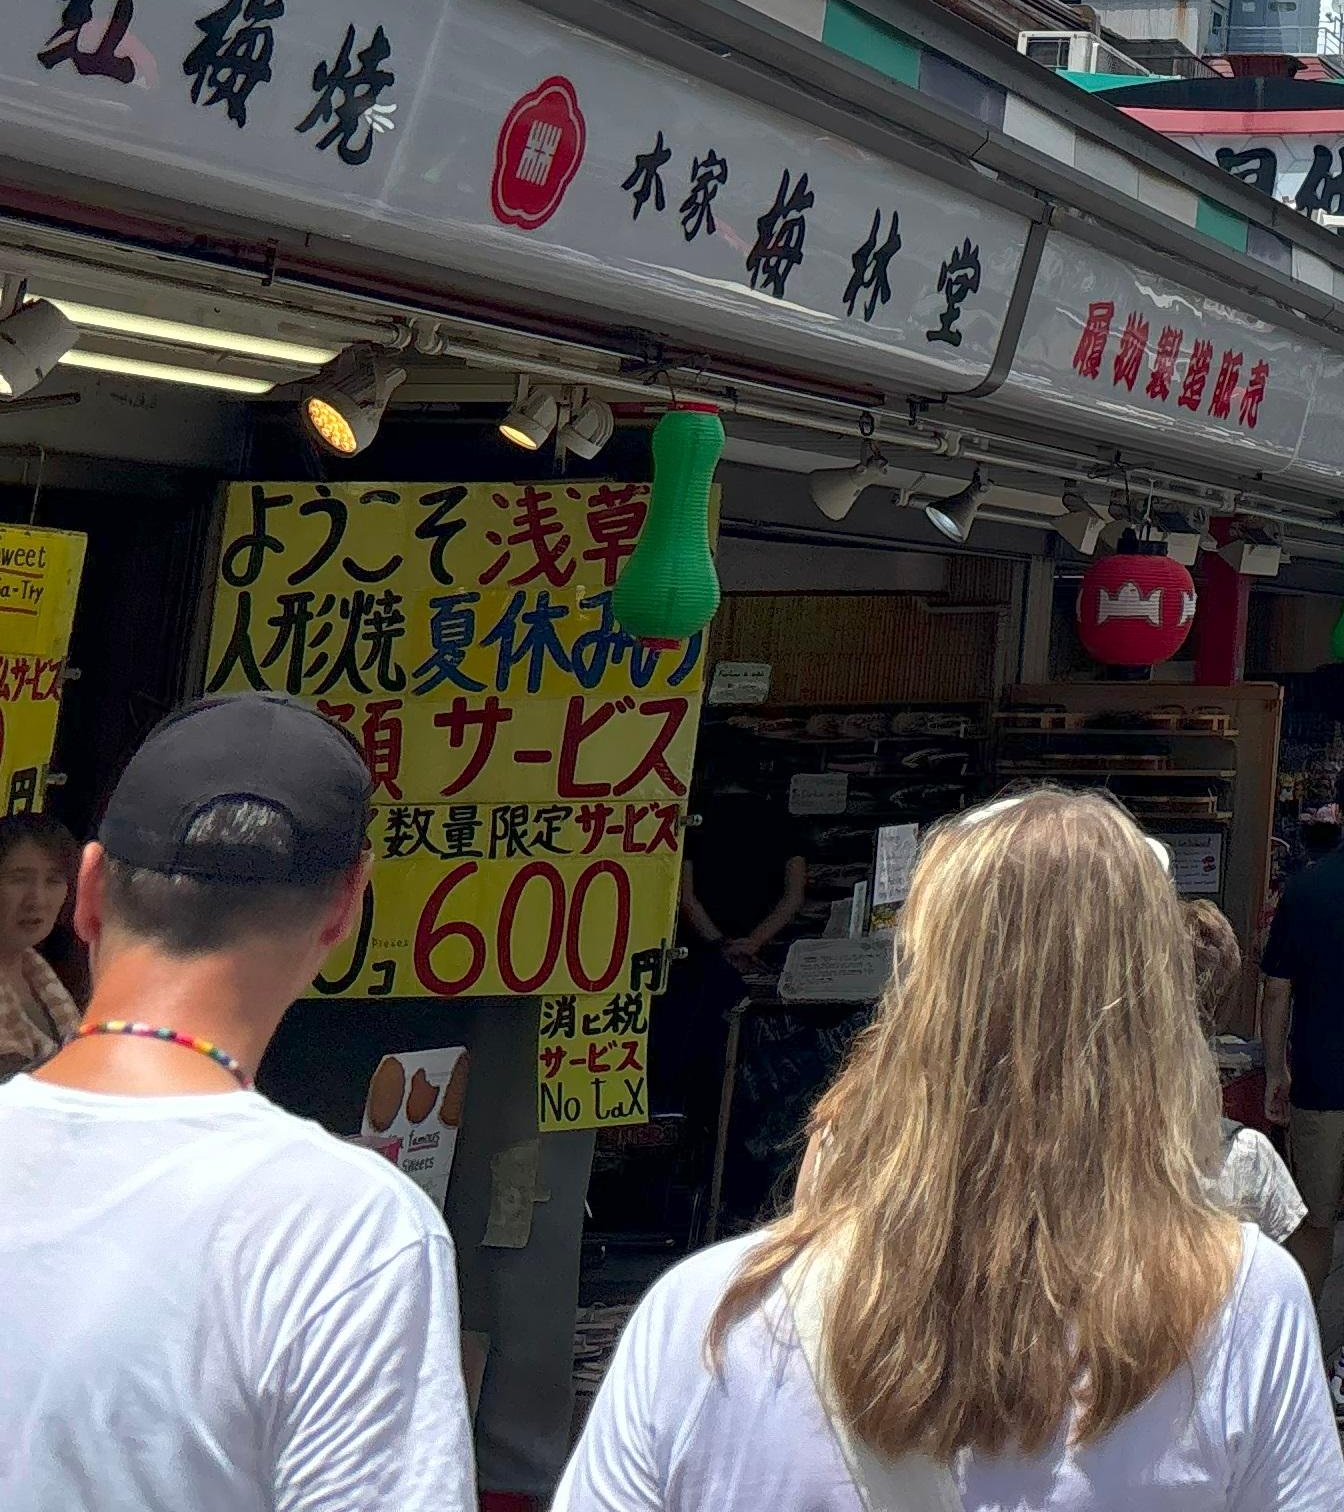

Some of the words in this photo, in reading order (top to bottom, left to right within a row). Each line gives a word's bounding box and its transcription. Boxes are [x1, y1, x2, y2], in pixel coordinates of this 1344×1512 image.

[1072, 299, 1270, 429] 履物製造販売
[0, 545, 47, 569] weet
[382, 803, 680, 860] 数量限定サービス
[540, 1041, 643, 1079] サービス
[541, 1082, 581, 1123] No
